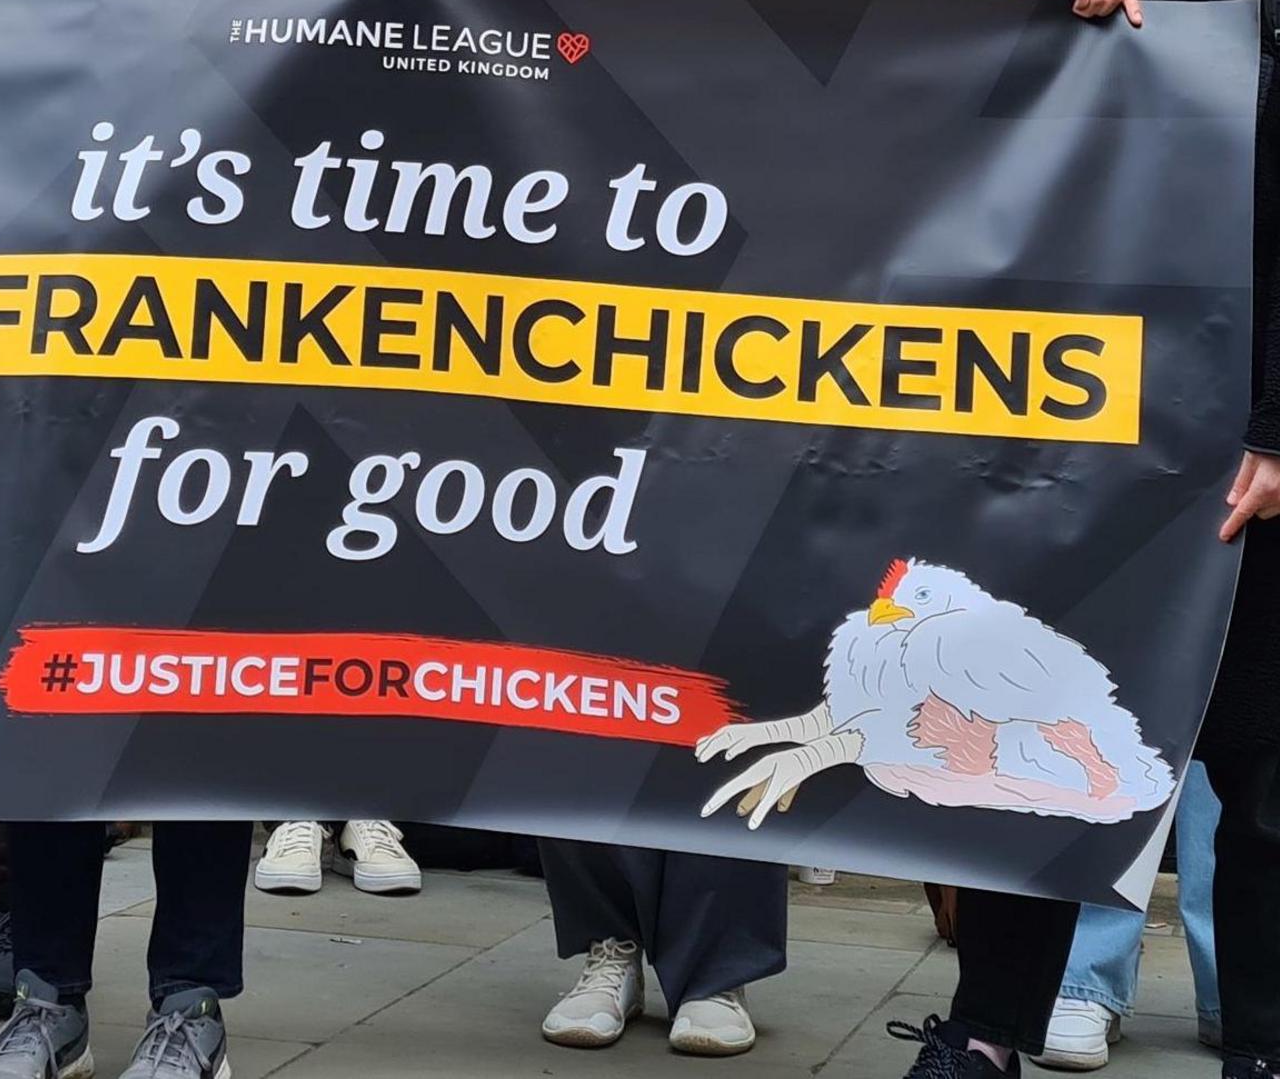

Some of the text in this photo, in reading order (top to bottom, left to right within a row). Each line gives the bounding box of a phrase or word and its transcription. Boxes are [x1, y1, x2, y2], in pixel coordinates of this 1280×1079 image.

[230, 18, 552, 60] THE HUMANE LEAGUE
[383, 56, 550, 81] UNITED KINGDOM
[70, 122, 729, 256] it's time to
[75, 415, 647, 561] for good
[40, 652, 680, 725] #JUSTICEFORCHICKENS
